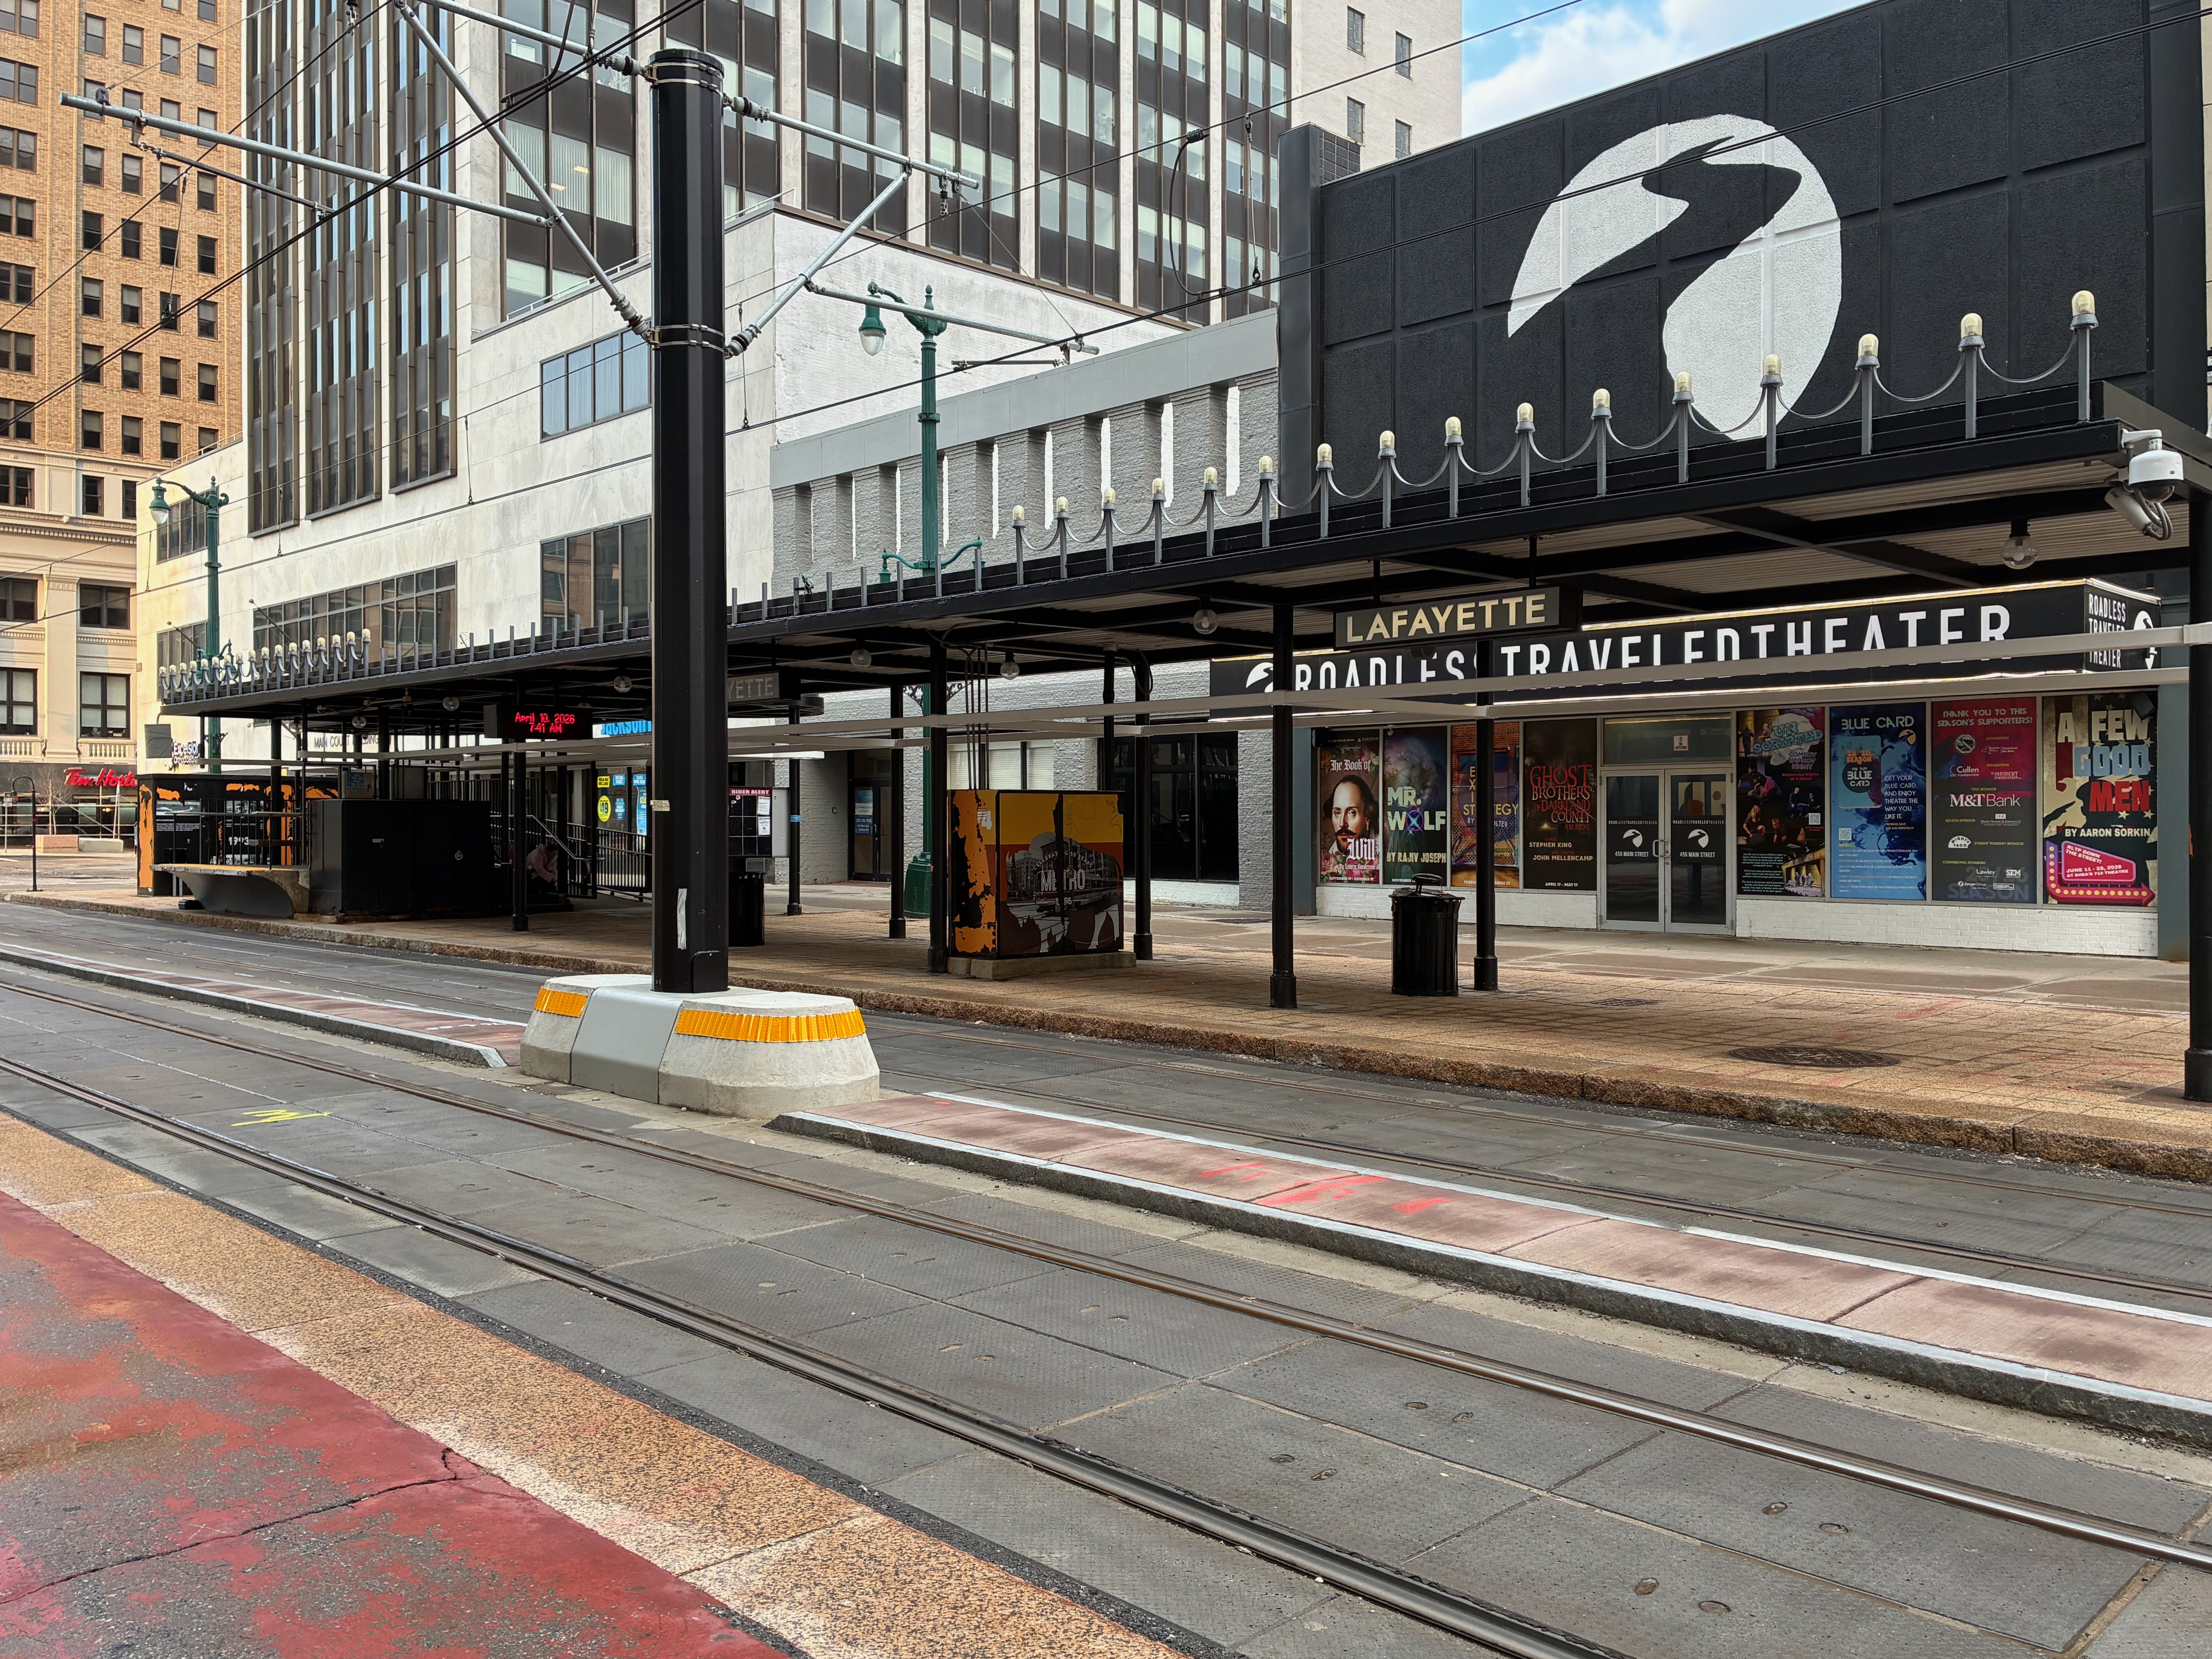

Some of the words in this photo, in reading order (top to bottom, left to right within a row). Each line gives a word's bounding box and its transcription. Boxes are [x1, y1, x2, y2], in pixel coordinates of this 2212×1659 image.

[2089, 593, 2126, 622] ROADLESS
[1347, 593, 1546, 642] LAFAYETTE
[727, 677, 773, 700] YETTE
[515, 712, 534, 722] April
[554, 714, 575, 724] 2026
[1842, 718, 1870, 730] BLUE
[1876, 716, 1914, 728] CARD
[1978, 717, 2032, 726] SUPPORTERS!
[529, 722, 545, 733] 7:41
[549, 723, 562, 733] AM
[1773, 721, 1798, 737] UN
[2058, 712, 2075, 743] A
[2092, 709, 2148, 741] FEW
[330, 736, 350, 747] COUT
[1753, 729, 1824, 754] SCRIPTED
[1330, 760, 1342, 772] The
[1344, 759, 1362, 772] Book
[1364, 759, 1371, 771] of
[2074, 745, 2149, 776] GOOD
[63, 768, 94, 787] Tim
[95, 768, 138, 787] Hort
[1530, 765, 1593, 788] GHOST
[1847, 770, 1872, 780] BLUE
[1387, 786, 1421, 807] MR.
[1532, 785, 1590, 800] BROTHERS
[2089, 780, 2150, 812] MEN
[1541, 799, 1590, 812] DARKLAND
[1949, 794, 1985, 807] M&T
[1987, 794, 2021, 807] Bank
[1463, 804, 1519, 816] STEGY
[1551, 811, 1590, 823] COUNTY
[2080, 828, 2112, 837] AARON
[2114, 828, 2150, 836] SORKIN
[1346, 838, 1376, 863] Will
[1387, 852, 1396, 862] BY
[1398, 852, 1418, 863] RAJIV
[1420, 852, 1446, 863] JOSEPH
[2083, 849, 2101, 858] DOWN
[1033, 850, 1068, 870] CELEBRATG
[2078, 853, 2102, 864] STREET!
